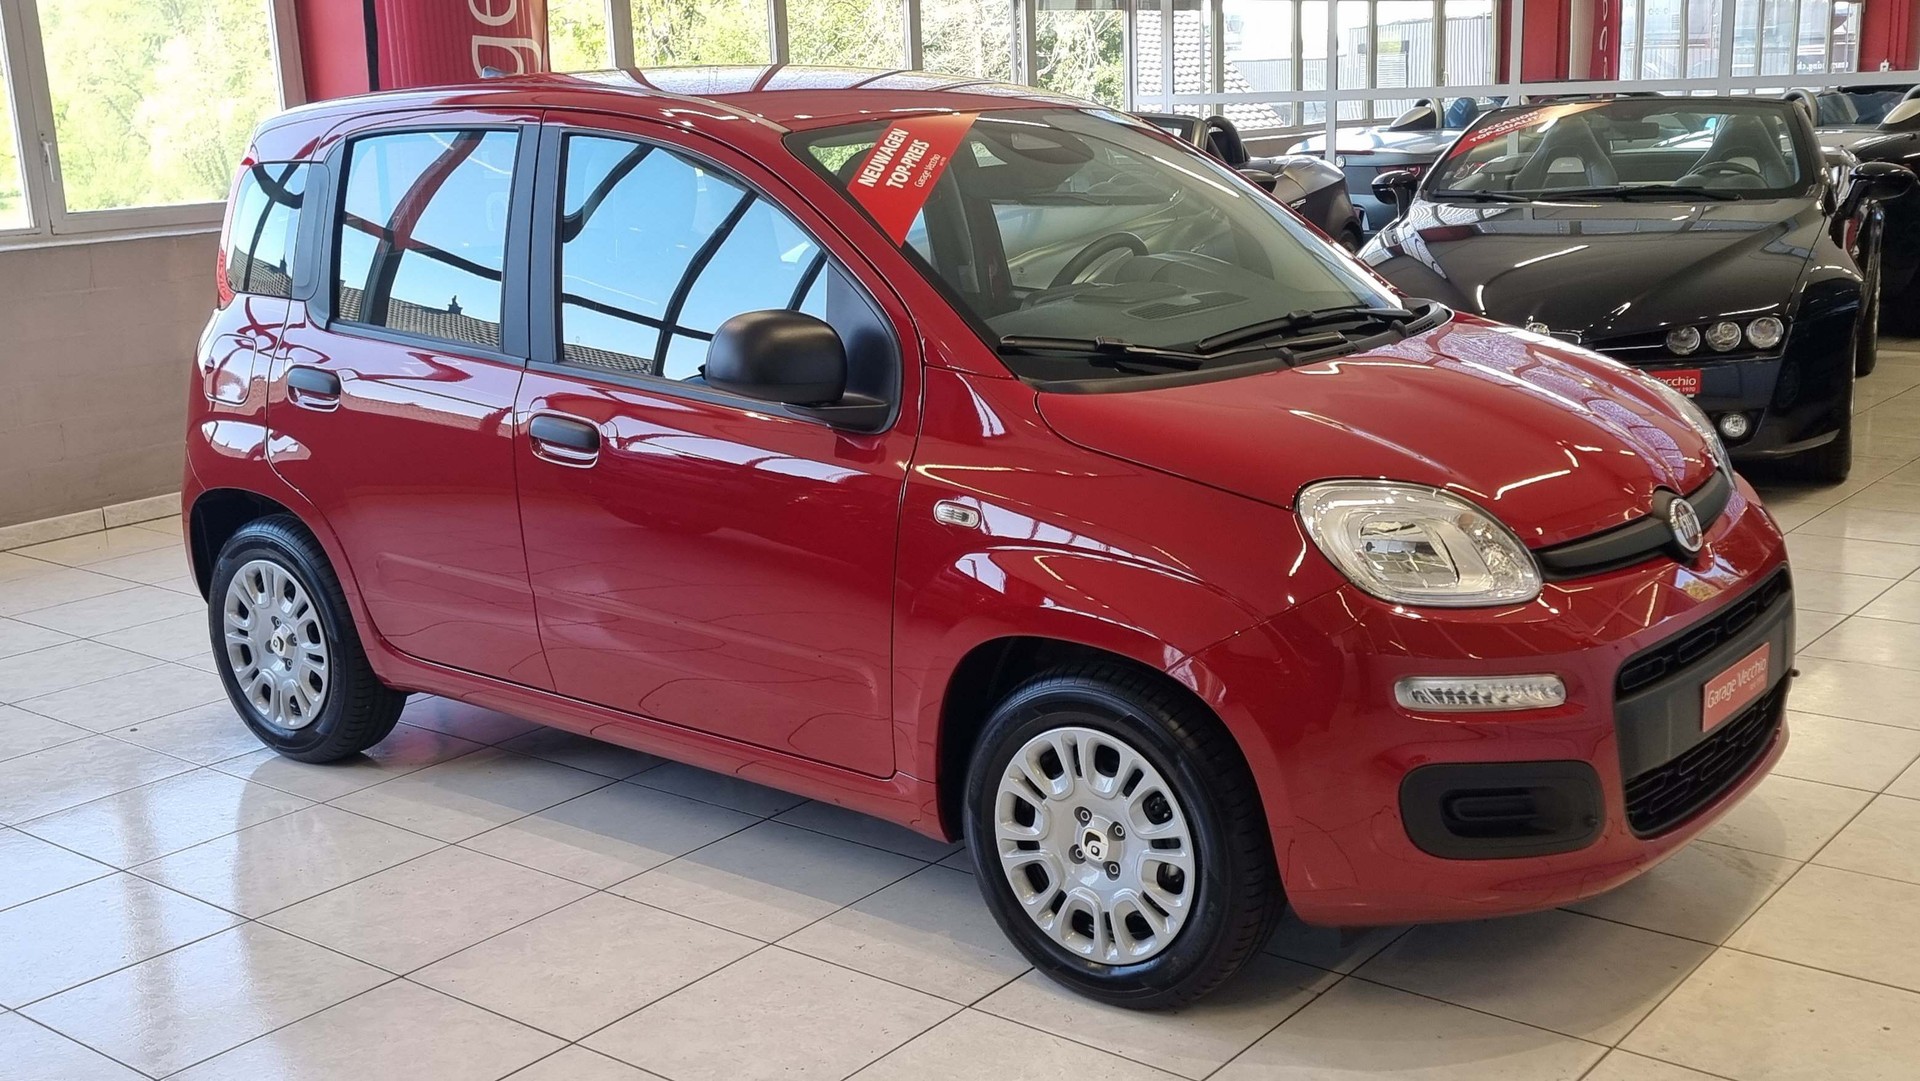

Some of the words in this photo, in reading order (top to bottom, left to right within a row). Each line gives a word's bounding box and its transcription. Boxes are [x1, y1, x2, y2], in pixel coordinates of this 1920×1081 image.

[1478, 111, 1538, 134] OCCASION
[857, 128, 910, 188] NEUWAGEN
[886, 139, 930, 189] TOP-PREIS
[914, 170, 932, 188] Garage
[1657, 376, 1697, 387] ecchio
[1707, 679, 1736, 709] Garage
[1737, 658, 1767, 687] Vecchio
